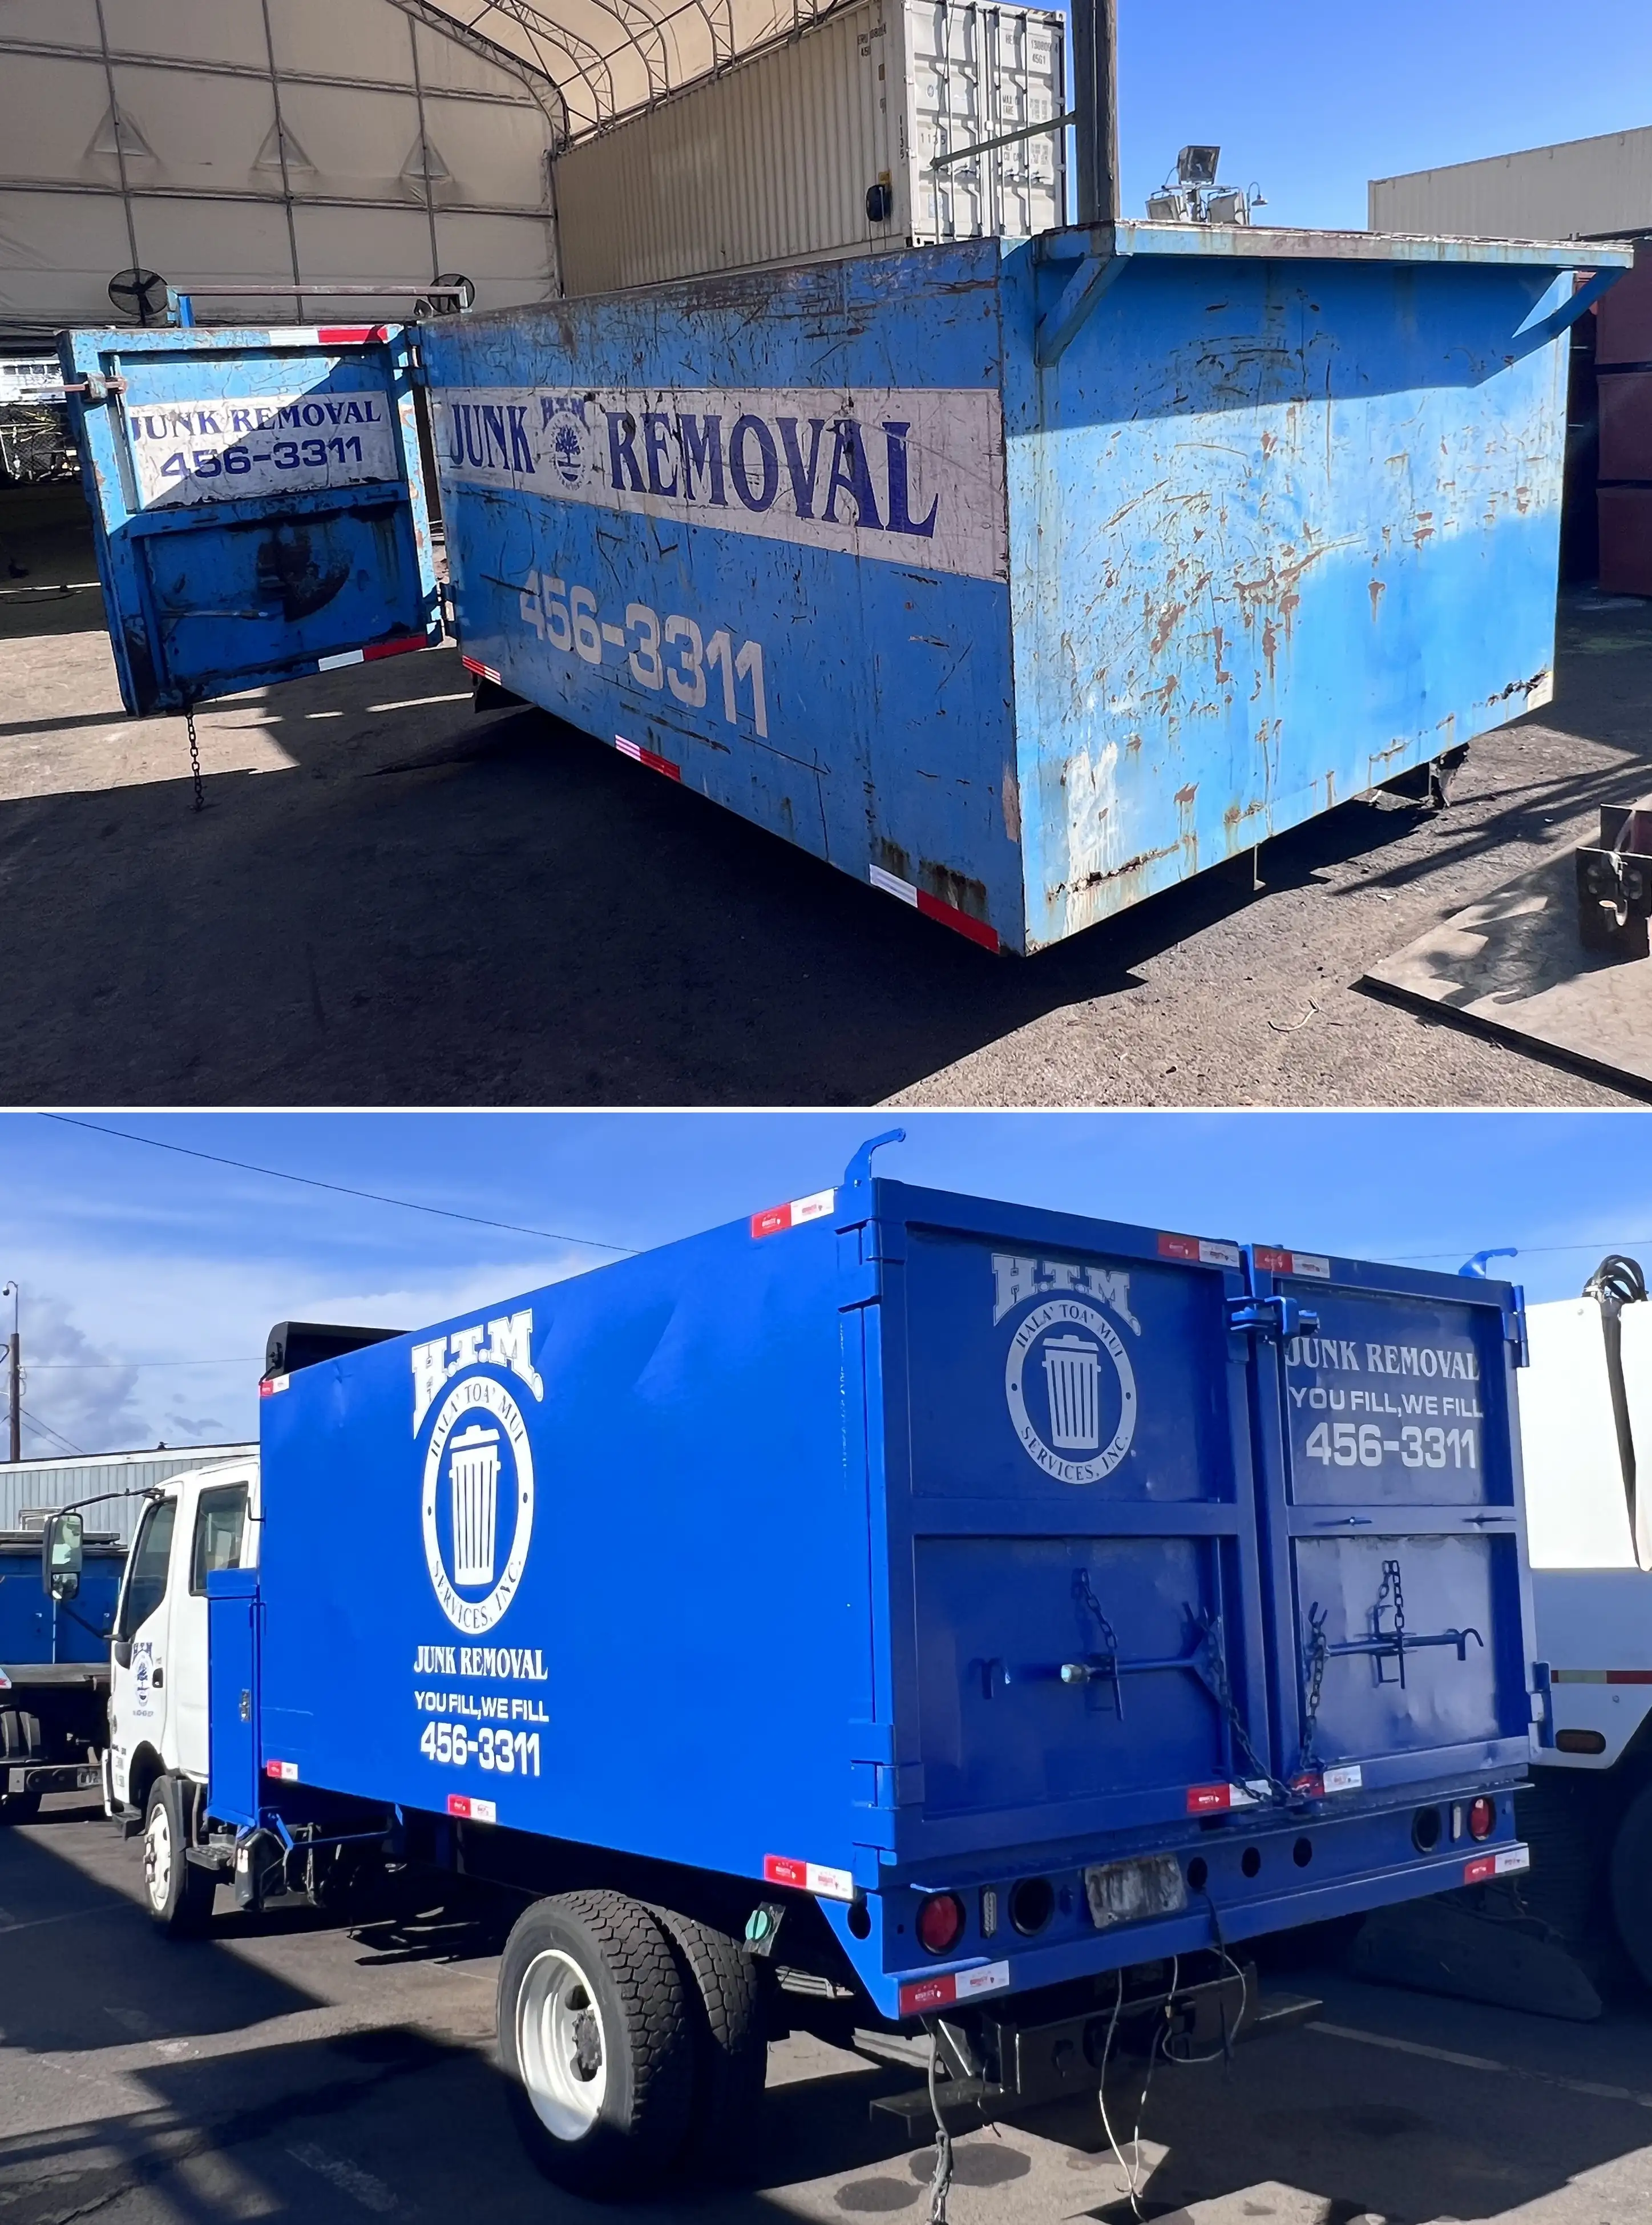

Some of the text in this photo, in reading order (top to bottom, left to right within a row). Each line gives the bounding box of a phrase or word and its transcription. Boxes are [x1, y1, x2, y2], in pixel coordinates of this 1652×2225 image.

[132, 400, 382, 442] JUNK REMOVAL
[160, 436, 363, 479] 456-3311
[450, 404, 535, 474] JUNK
[605, 412, 939, 539] REMOVAL
[519, 569, 768, 739] 456-3311
[1285, 1336, 1480, 1381] JUNK REMOVAL
[1289, 1386, 1345, 1410] YOU
[1443, 1396, 1484, 1418] FILL
[1306, 1421, 1476, 1469] 456-3311
[413, 1645, 548, 1680] JUNK REMOVAL
[414, 1691, 447, 1712] YOU
[511, 1698, 550, 1723] FILL
[420, 1721, 540, 1777] 456-3311
